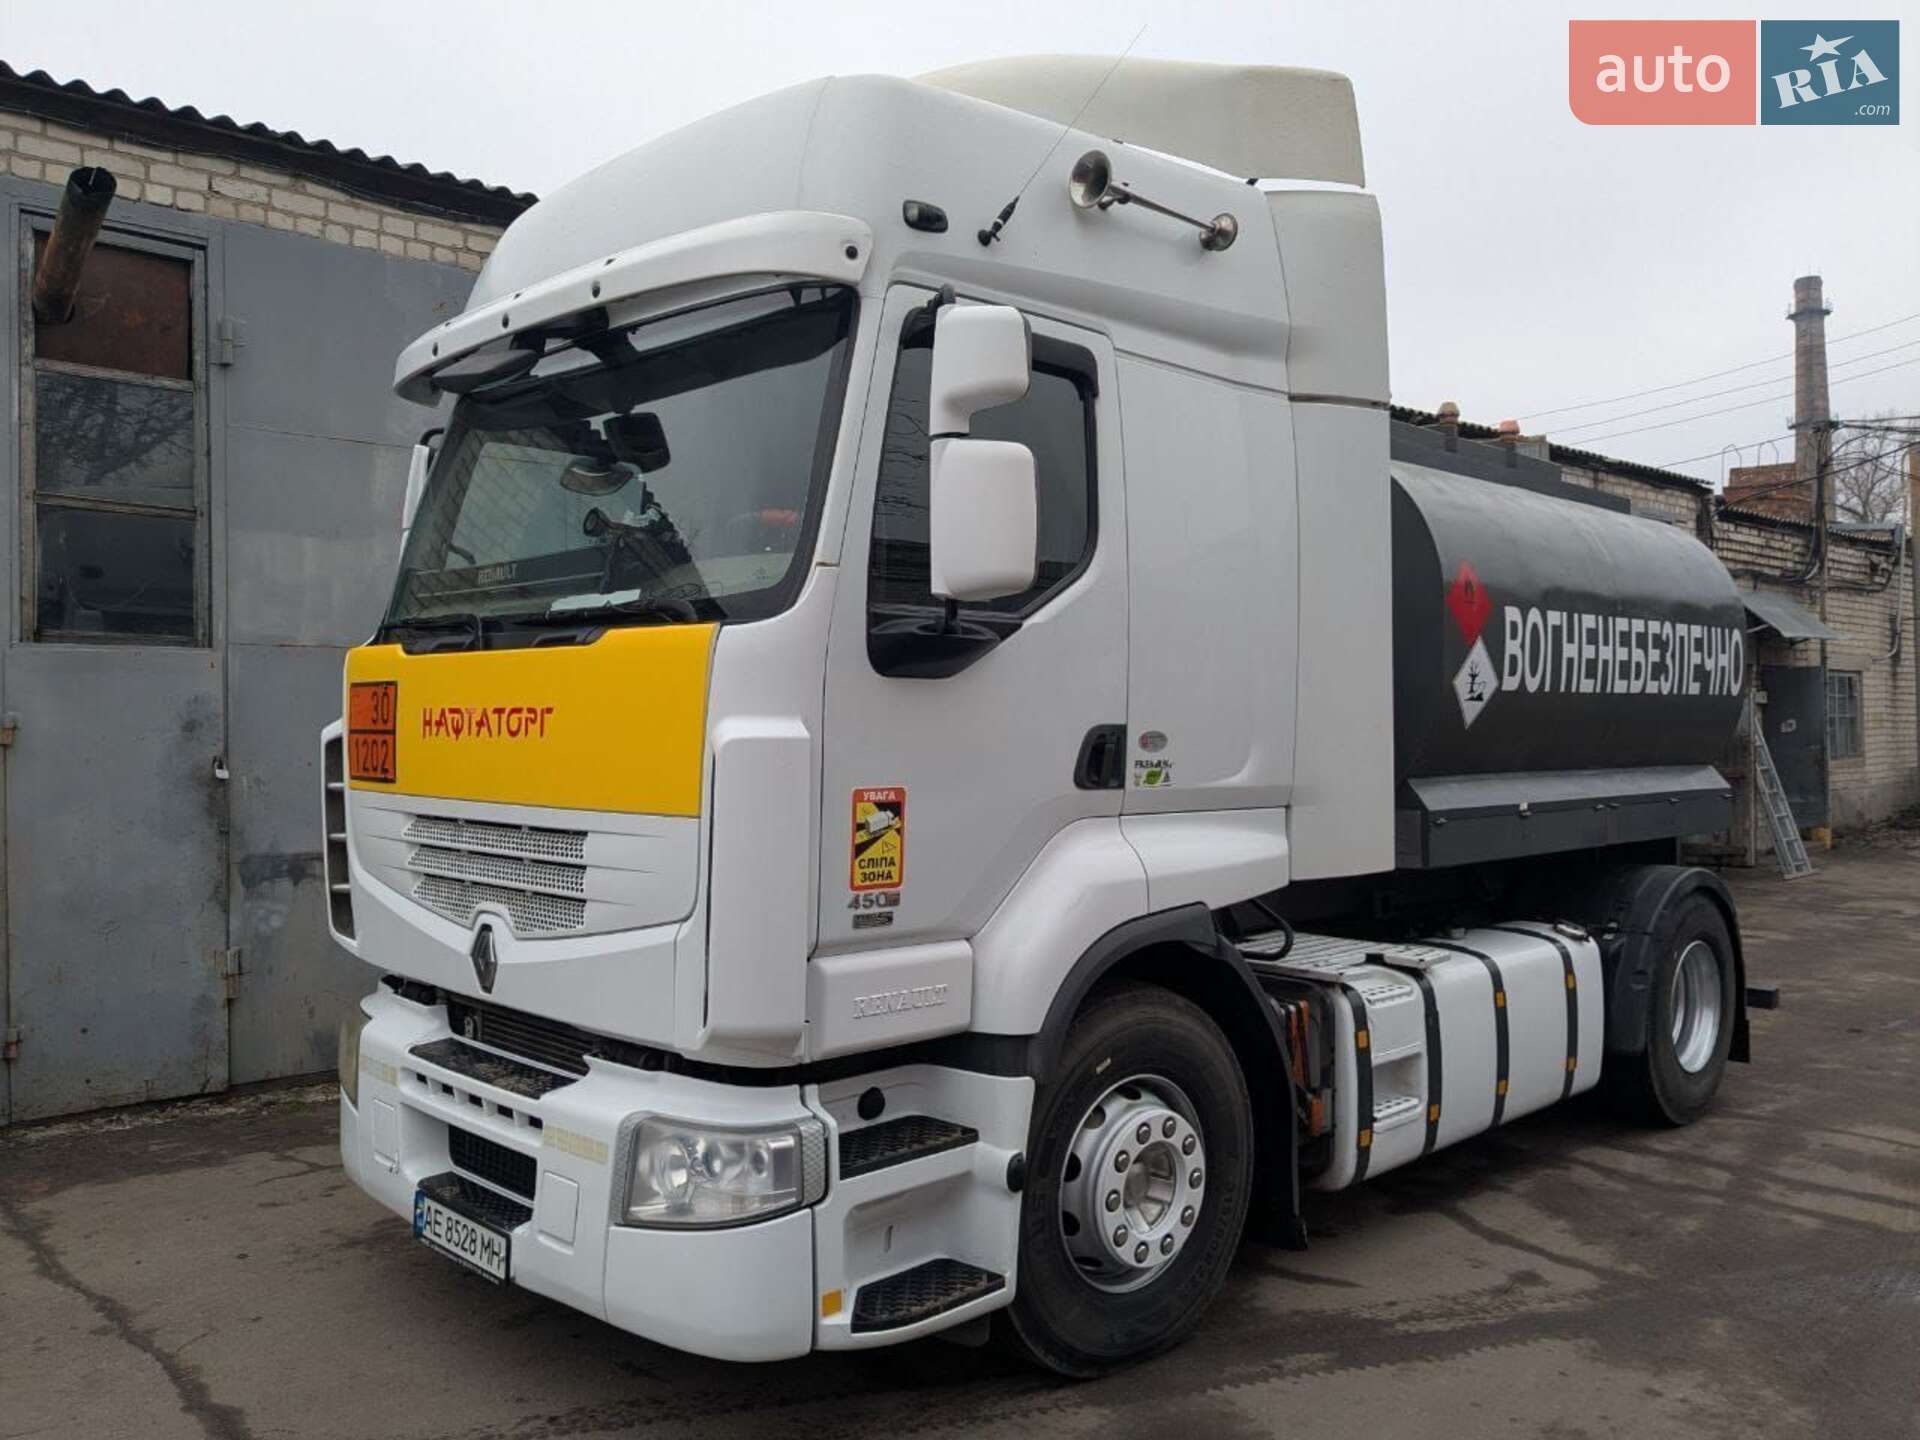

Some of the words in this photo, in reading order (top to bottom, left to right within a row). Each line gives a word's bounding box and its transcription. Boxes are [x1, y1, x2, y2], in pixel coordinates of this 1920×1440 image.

[1501, 605, 1744, 697] ВОГНЕНЕБЕЗПЕЧНО
[371, 691, 390, 725] 30
[422, 707, 554, 741] НАФТАТОРГ
[355, 739, 390, 774] 1202
[863, 790, 897, 801] УВАГА
[858, 856, 896, 869] СЛІПА
[860, 870, 893, 883] ЗОНА
[847, 891, 887, 910] 450
[424, 1204, 443, 1239] AE
[445, 1216, 477, 1256] 8528
[479, 1232, 503, 1271] MH
